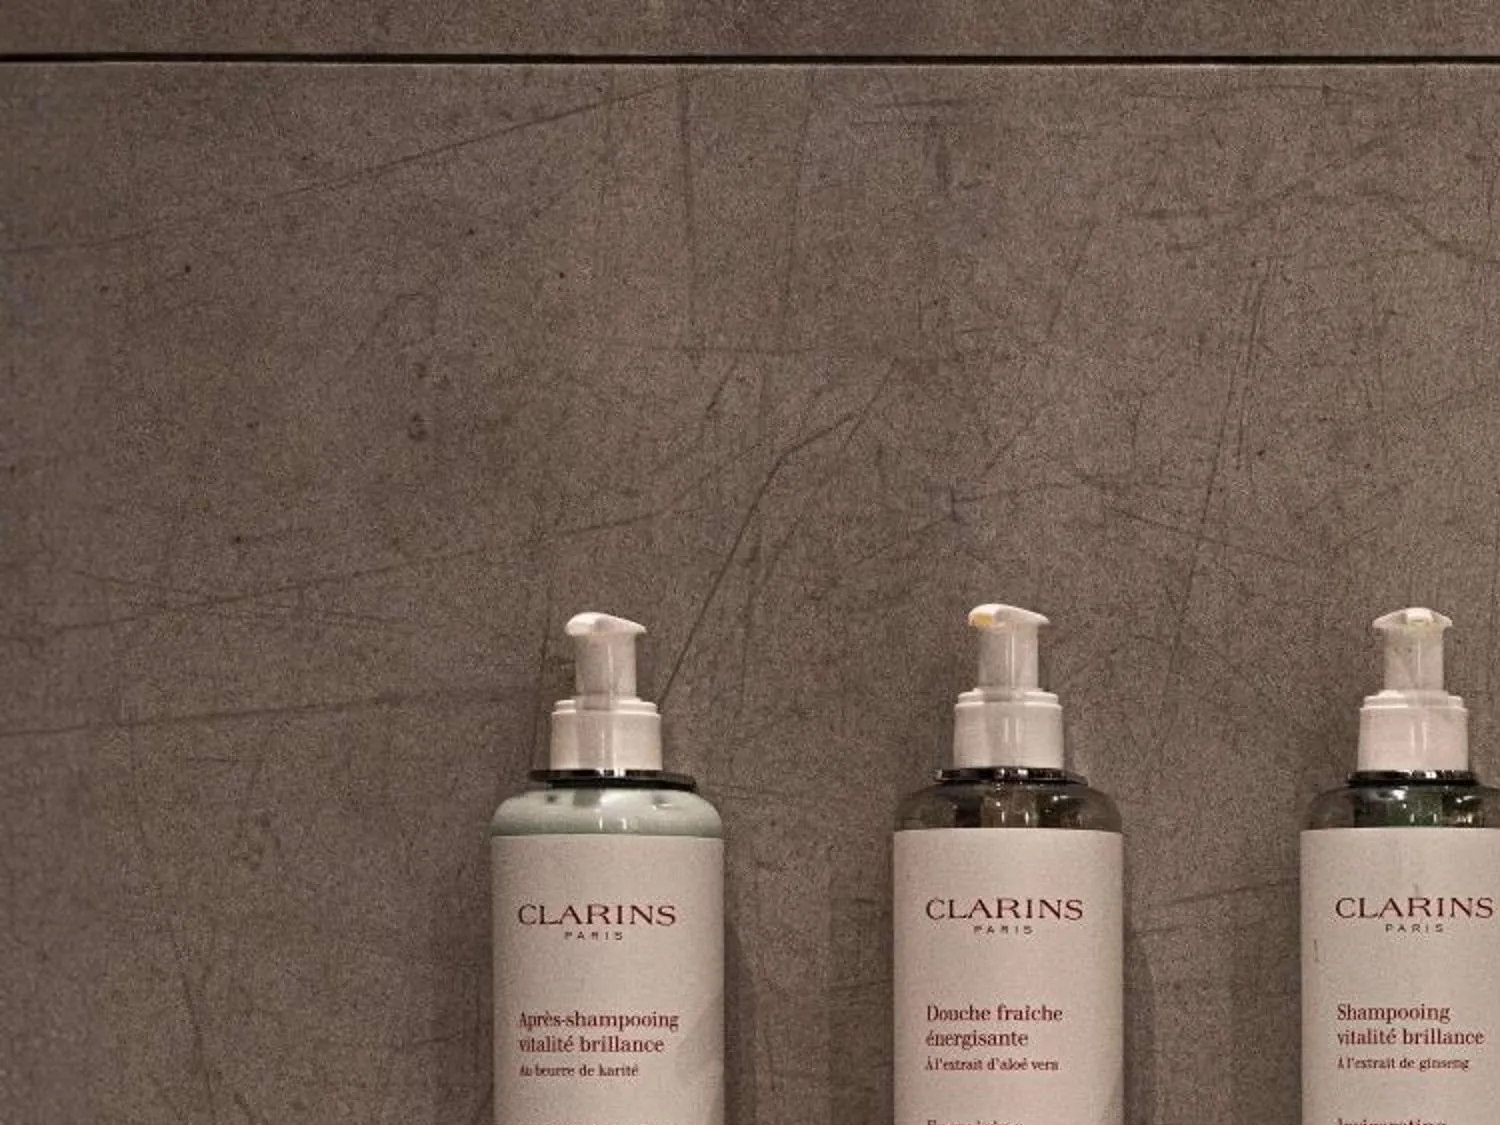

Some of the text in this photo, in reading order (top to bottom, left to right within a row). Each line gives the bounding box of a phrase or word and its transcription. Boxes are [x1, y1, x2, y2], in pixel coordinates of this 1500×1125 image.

[517, 902, 677, 926] CLARINS
[926, 898, 1084, 920] CLARINS
[1336, 897, 1494, 919] CLARINS
[564, 932, 623, 941] PARIS
[974, 926, 1033, 935] PARIS
[1386, 924, 1444, 933] PARIS
[519, 1010, 680, 1033] Après-shampooing
[927, 1004, 991, 1022] Douche
[1337, 1003, 1451, 1024] Shampooing
[519, 1035, 665, 1053] vitalité brillance
[926, 1029, 1029, 1050] énergisante
[1337, 1028, 1486, 1046] vitalité brillance
[535, 1064, 575, 1077] beurre
[579, 1064, 595, 1077] de
[599, 1064, 639, 1077] karité
[1031, 1060, 1059, 1071] vera
[1399, 1056, 1416, 1069] de
[1419, 1057, 1470, 1072] ginseng
